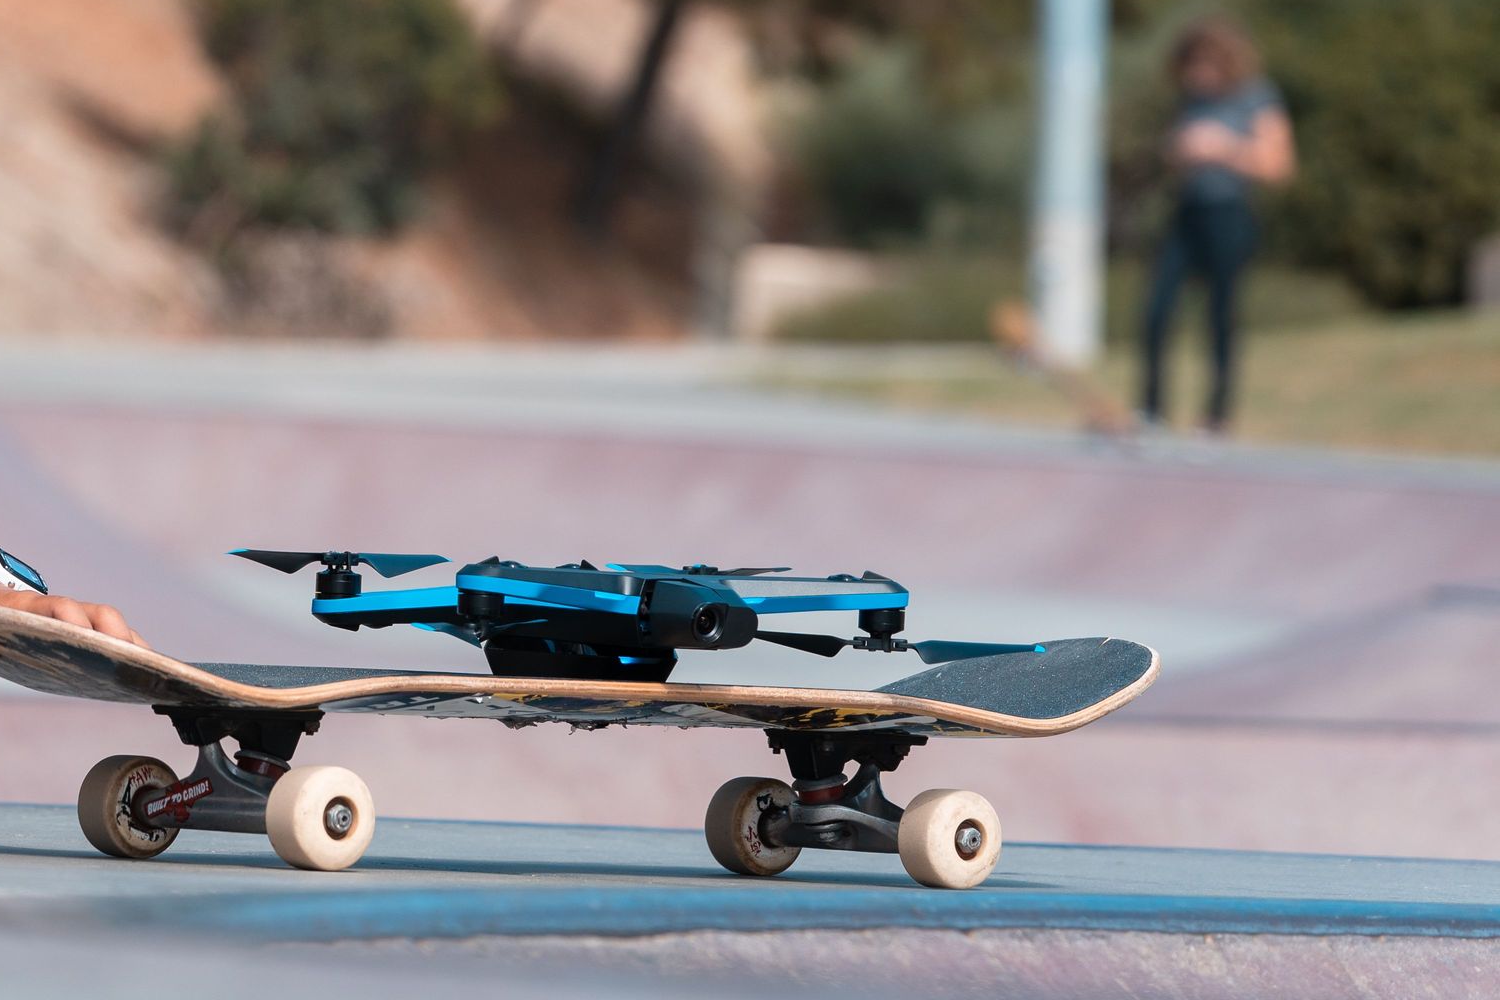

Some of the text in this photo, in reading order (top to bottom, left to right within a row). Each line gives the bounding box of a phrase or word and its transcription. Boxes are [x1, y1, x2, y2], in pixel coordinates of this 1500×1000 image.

[147, 780, 209, 816] BUILT TO GRIND!
